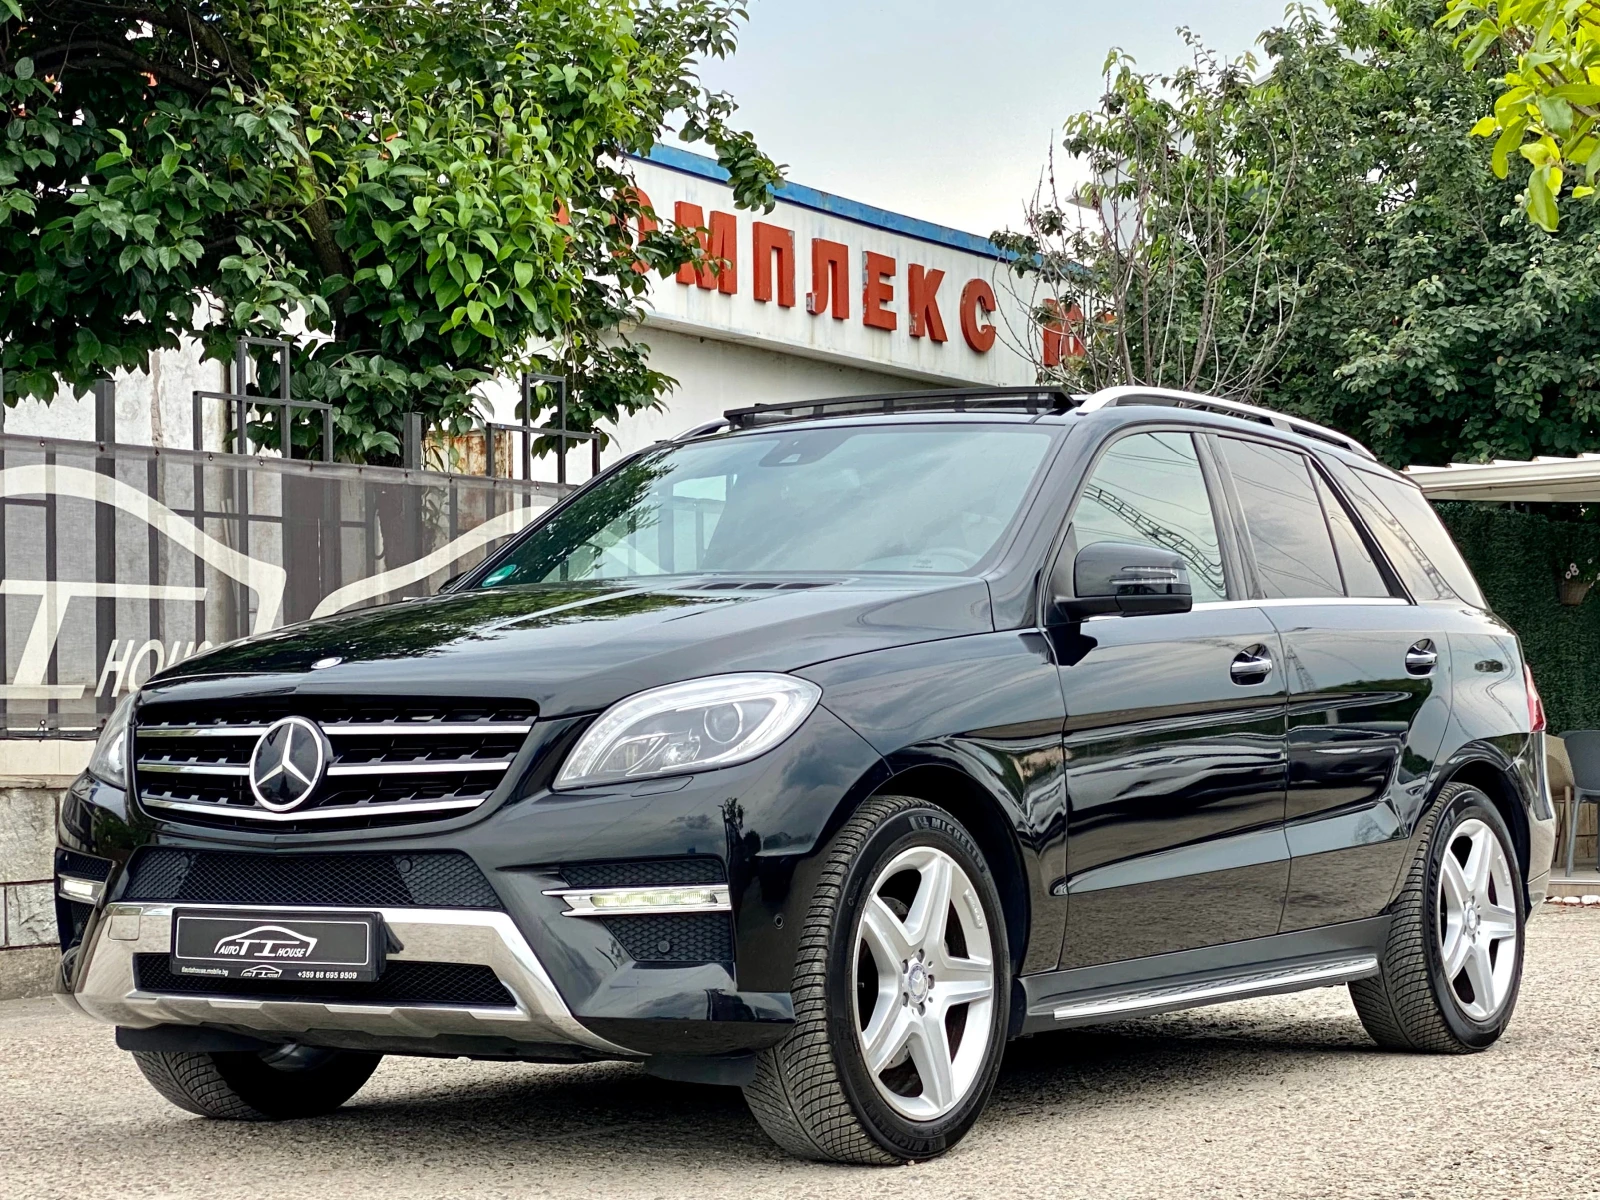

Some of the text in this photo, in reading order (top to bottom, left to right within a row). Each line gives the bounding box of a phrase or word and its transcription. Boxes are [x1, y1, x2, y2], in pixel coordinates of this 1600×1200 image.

[931, 816, 984, 869] MICHELIN
[218, 945, 239, 955] AUTO
[276, 947, 306, 957] HOUSE
[297, 971, 358, 980] +359 88 695 9509
